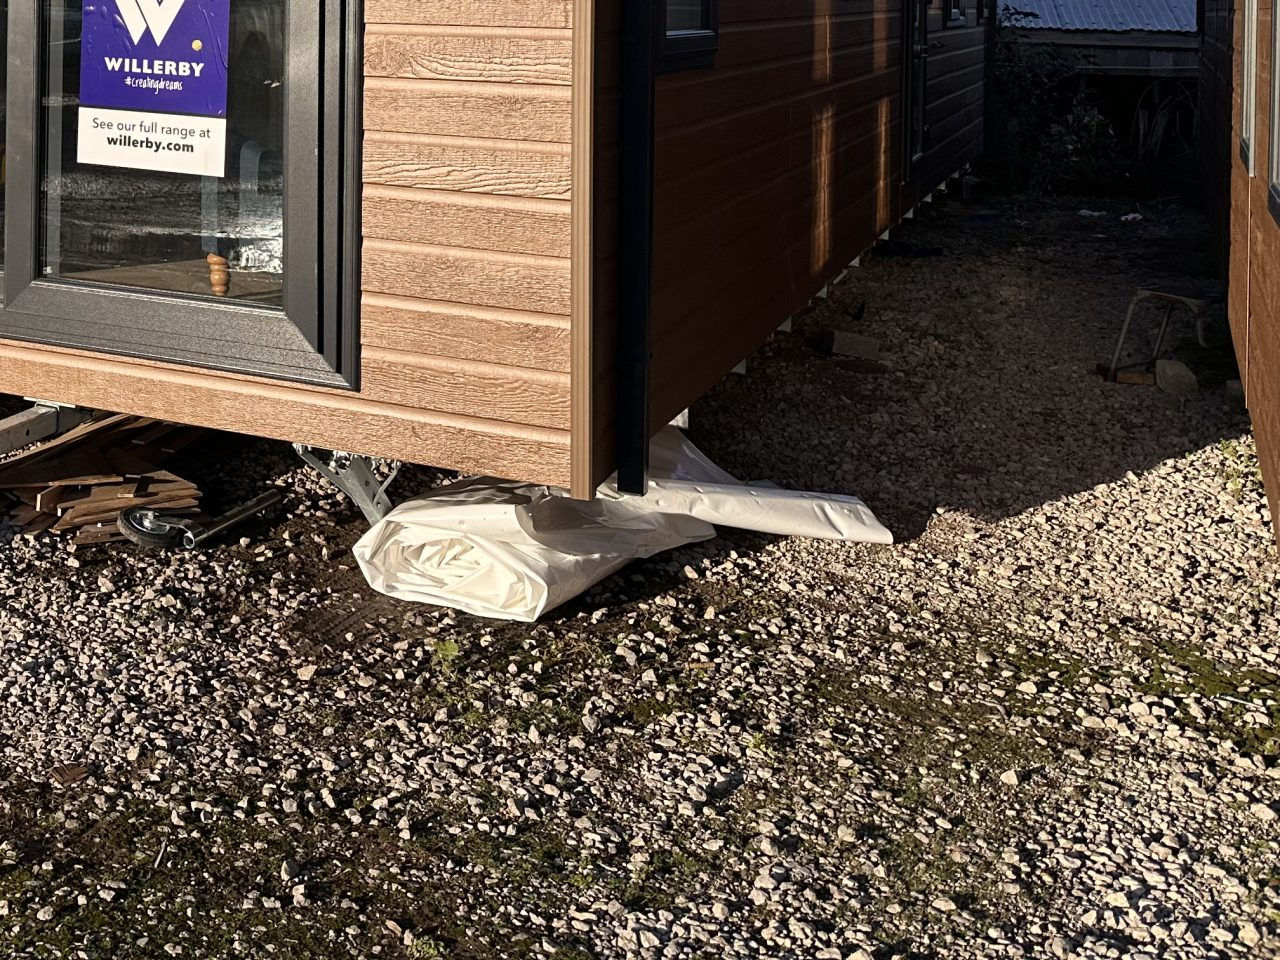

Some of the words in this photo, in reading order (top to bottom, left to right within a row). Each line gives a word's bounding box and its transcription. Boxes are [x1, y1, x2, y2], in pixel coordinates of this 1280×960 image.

[104, 56, 204, 77] WILLERBY
[124, 76, 183, 94] #creatingdreams
[92, 117, 114, 130] See
[117, 121, 136, 132] our
[139, 120, 158, 134] full
[161, 125, 195, 140] range
[199, 128, 211, 139] at
[107, 135, 194, 153] willerby.com
